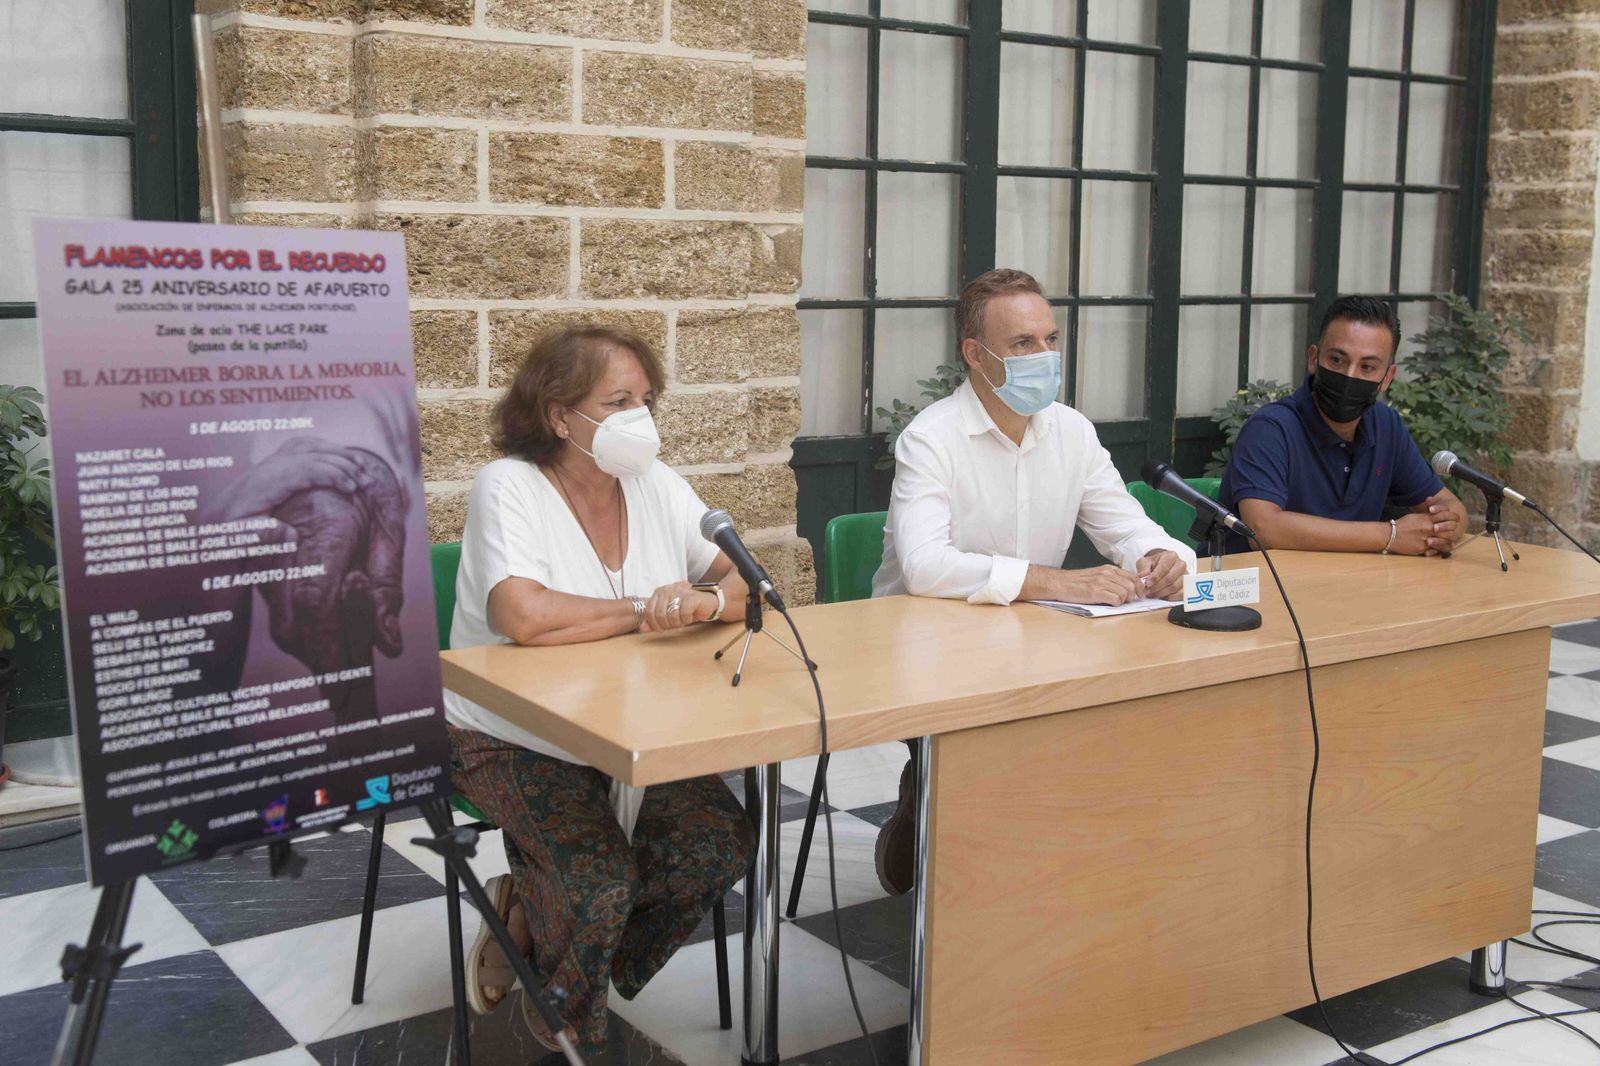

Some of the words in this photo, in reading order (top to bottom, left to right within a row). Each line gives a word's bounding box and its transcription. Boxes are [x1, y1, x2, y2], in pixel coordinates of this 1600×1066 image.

[64, 244, 204, 269] FLAMENCOS
[211, 247, 251, 270] POR
[258, 249, 282, 271] EL
[288, 250, 385, 273] RECUERDO
[65, 279, 114, 295] GALA
[122, 279, 144, 295] 25
[151, 280, 270, 296] ANIVERSARIO
[277, 282, 298, 297] DE
[304, 282, 390, 297] AFAPUERTO
[155, 324, 187, 337] Zona
[190, 325, 205, 336] de
[209, 325, 232, 336] ocio
[237, 323, 262, 335] THE
[266, 323, 295, 335] LACE
[299, 323, 328, 334] PARK
[187, 340, 226, 354] (paseo
[230, 340, 244, 351] de
[248, 340, 260, 351] la
[63, 369, 89, 387] EL
[95, 366, 212, 386] ALZHEIMER
[219, 365, 284, 382] BORRA
[289, 363, 313, 380] LA
[141, 391, 173, 408] NO
[180, 389, 216, 407] LOS
[190, 422, 199, 435] 5
[200, 421, 218, 434] DE
[219, 418, 272, 433] AGOSTO
[77, 465, 110, 478] JUAN
[112, 461, 164, 475] ANTONIO
[166, 460, 181, 471] DE
[183, 458, 205, 470] LOS
[129, 490, 145, 501] DE
[147, 488, 170, 500] LOS
[81, 505, 125, 520] NOELIA
[127, 503, 143, 515] DE
[145, 501, 168, 513] LOS
[83, 532, 145, 548] ACADEMIA
[147, 528, 162, 541] DE
[165, 525, 197, 540] BAILE
[84, 545, 147, 562] ACADEMIA
[148, 542, 163, 555] DE
[165, 539, 197, 553] BAILE
[85, 559, 148, 576] ACADEMIA
[150, 555, 165, 569] DE
[167, 552, 199, 566] BAILE
[200, 547, 247, 563] CARMEN
[248, 541, 297, 558] MORALES
[202, 578, 211, 591] 6
[213, 575, 230, 589] DE
[232, 569, 284, 586] AGOSTO
[1216, 576, 1257, 589] Diputación
[1217, 591, 1227, 601] de
[1229, 589, 1251, 600] Cádiz
[90, 614, 106, 628] EL
[91, 629, 102, 641] A
[155, 619, 170, 632] DE
[172, 617, 187, 629] EL
[188, 610, 233, 626] PUERTO
[125, 637, 142, 650] DE
[143, 634, 158, 647] EL
[159, 627, 206, 645] PUERTO
[144, 661, 159, 675] DE
[100, 718, 162, 740] ACADEMIA
[162, 714, 179, 728] DE
[391, 766, 442, 785] Diputación
[393, 789, 407, 802] de
[408, 782, 434, 797] Cádiz
